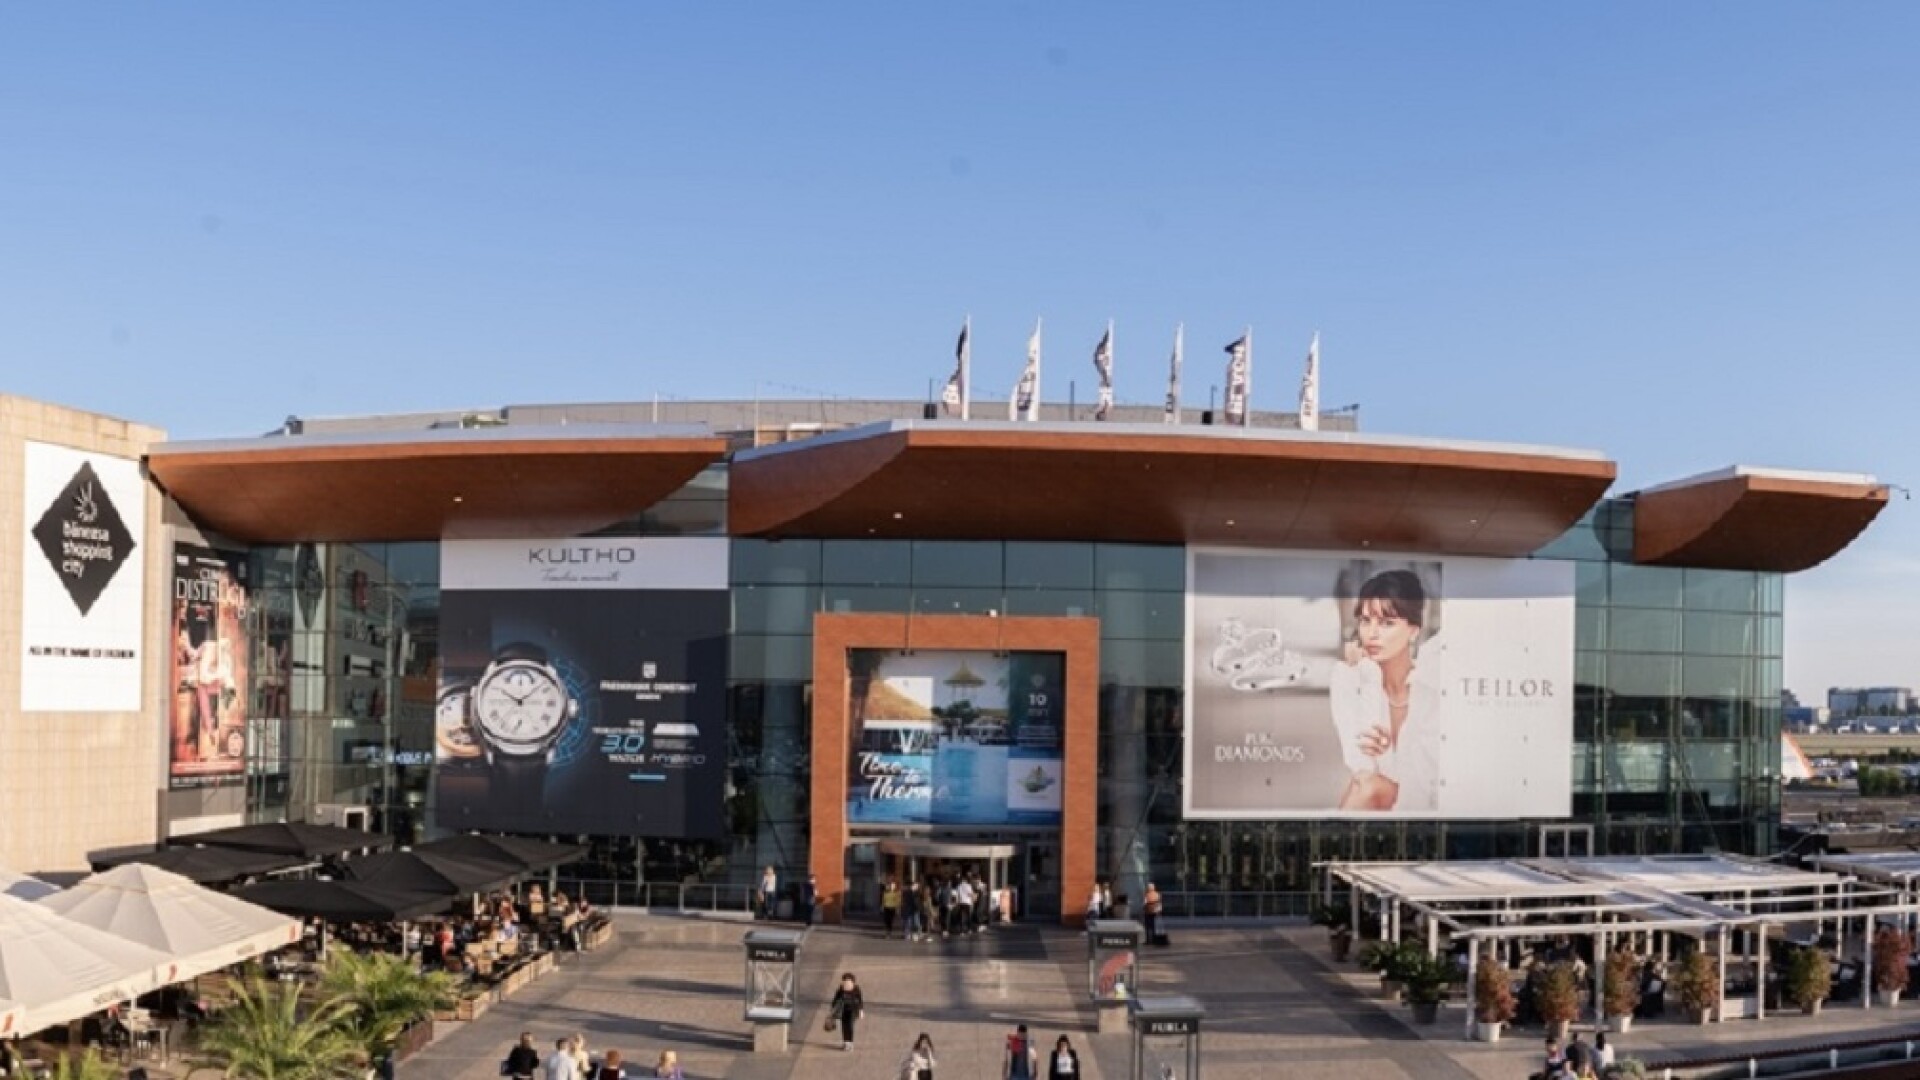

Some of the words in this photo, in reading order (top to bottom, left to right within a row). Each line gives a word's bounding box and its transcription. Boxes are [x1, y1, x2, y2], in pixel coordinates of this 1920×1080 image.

[529, 547, 636, 563] KULTHO
[1459, 677, 1554, 698] TEILOR
[1215, 744, 1305, 763] DIAMONDS
